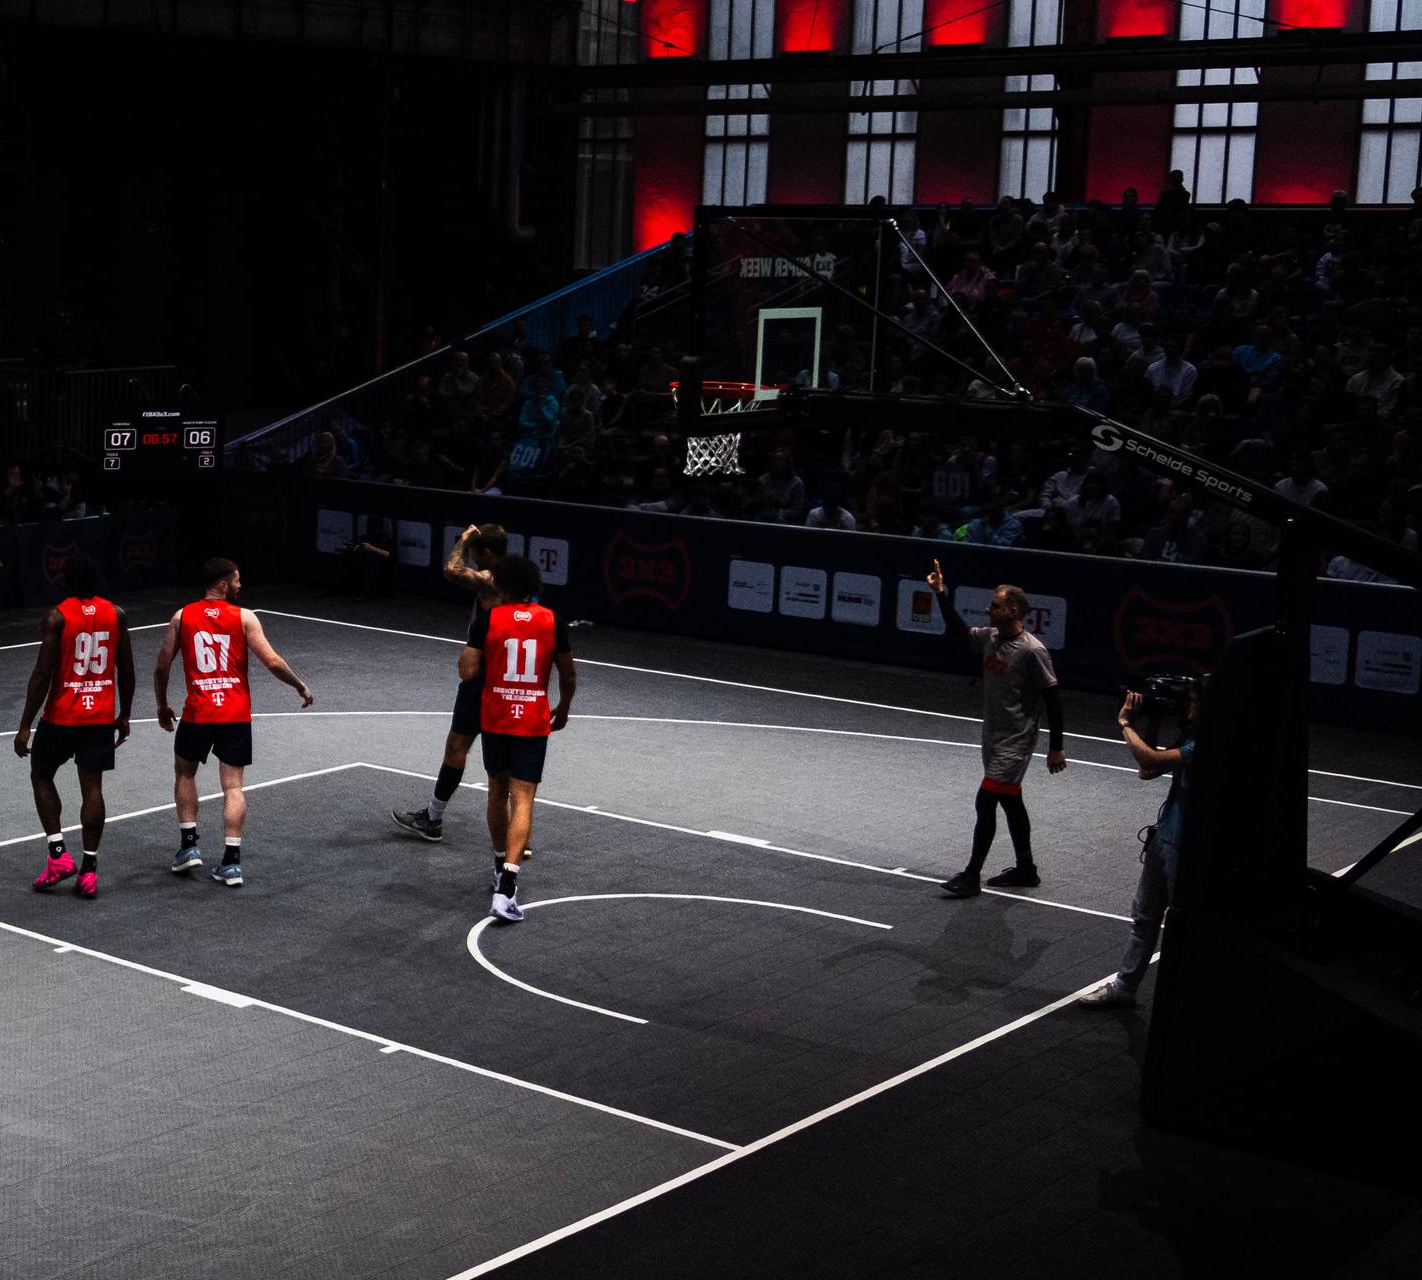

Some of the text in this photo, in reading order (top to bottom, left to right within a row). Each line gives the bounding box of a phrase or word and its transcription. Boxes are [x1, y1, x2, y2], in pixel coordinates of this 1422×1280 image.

[111, 432, 131, 446] 07
[189, 430, 211, 445] 06
[109, 459, 116, 468] 7
[203, 457, 211, 466] 2
[509, 443, 542, 469] GO!
[1195, 469, 1253, 502] Sports
[73, 631, 110, 676] 95
[193, 630, 231, 674] 67
[503, 638, 538, 683] 11
